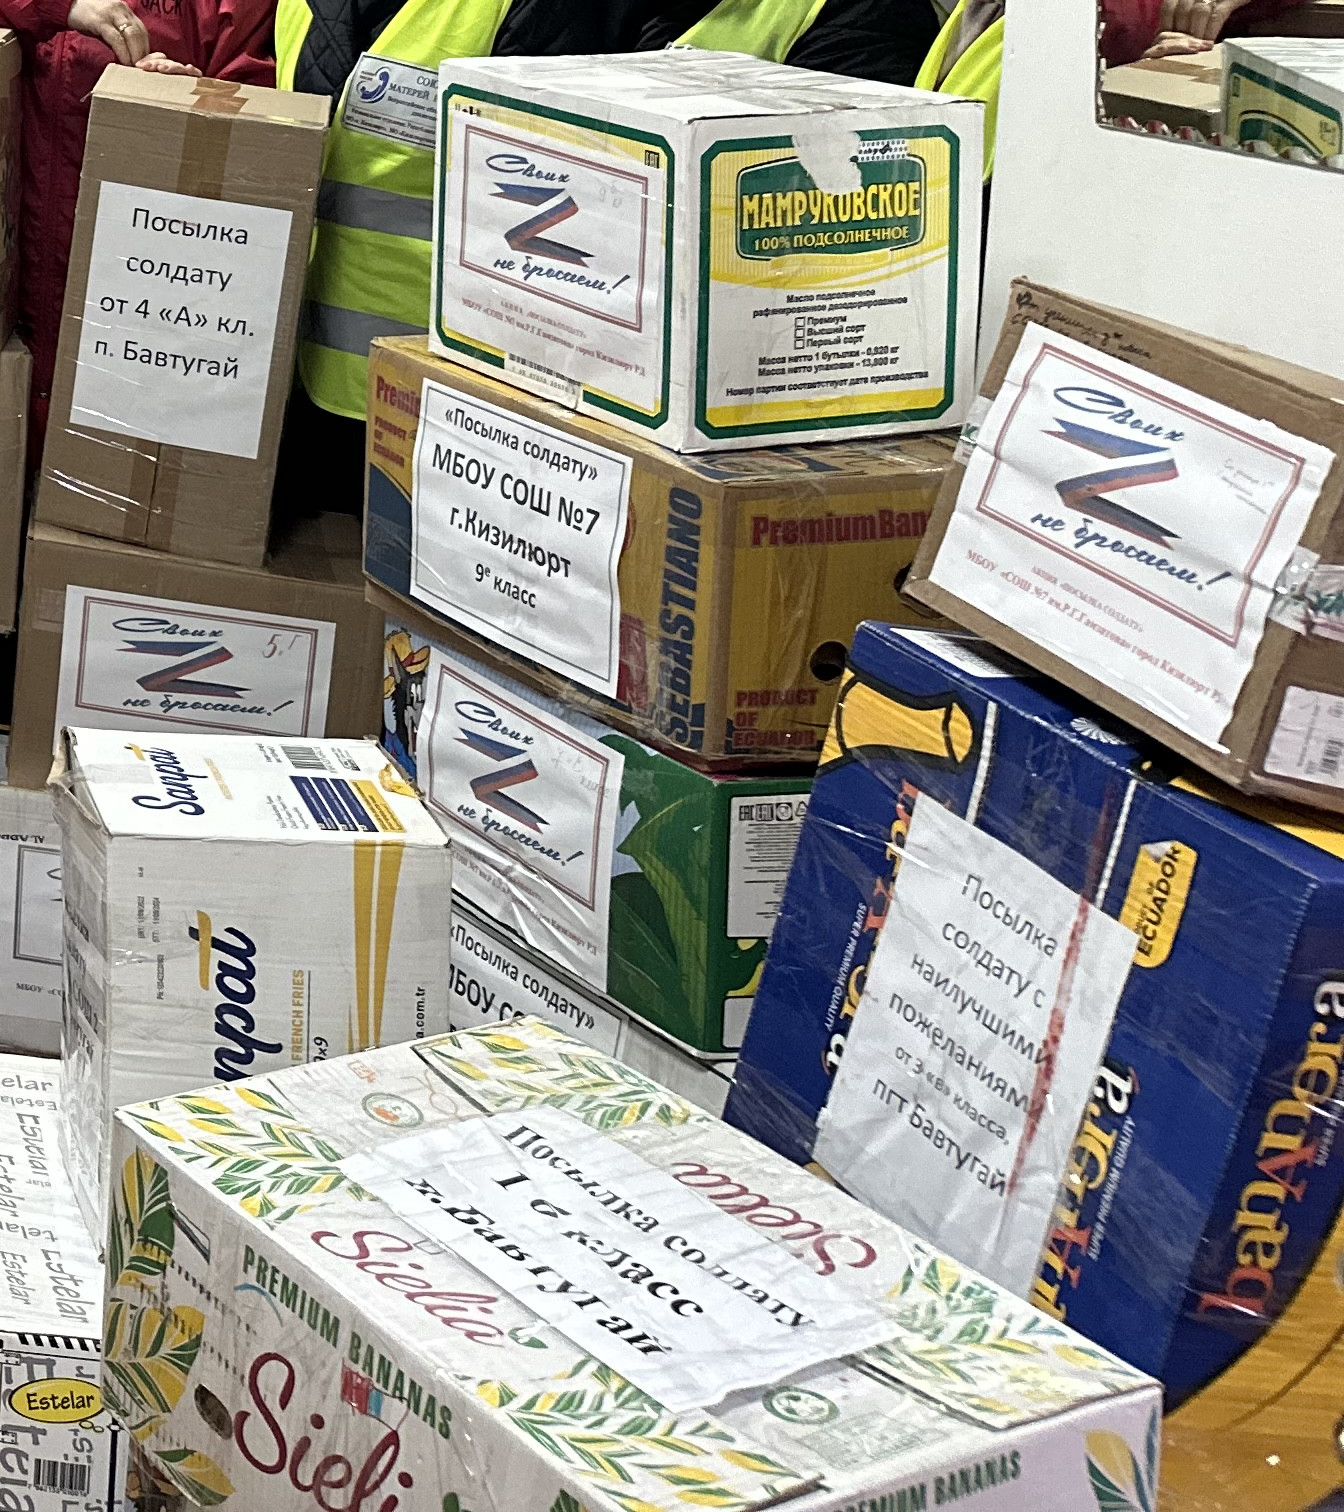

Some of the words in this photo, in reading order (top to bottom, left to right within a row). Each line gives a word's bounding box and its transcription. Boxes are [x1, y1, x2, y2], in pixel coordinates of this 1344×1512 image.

[131, 207, 250, 246] Посылка
[741, 181, 920, 231] МАМРУКОВСКОЕ
[753, 235, 791, 252] 100%
[793, 224, 910, 250] ПОДСОЛНЕЧНОЕ
[449, 503, 572, 579] г.Кизилюрт
[656, 487, 704, 745] SEBASTIANO
[734, 690, 818, 709] PRODUCT
[734, 711, 758, 729] OF
[961, 870, 1059, 958] Посылка
[292, 969, 305, 1008] FRIES
[941, 919, 1030, 990] солдату
[1033, 989, 1045, 1010] с
[291, 1012, 303, 1063] FRENCH
[910, 952, 1056, 1067] наилучшими
[888, 989, 1043, 1120] пожеланиями
[894, 1044, 913, 1063] от
[913, 1058, 925, 1077] 3
[952, 1094, 1010, 1148] класса,
[872, 1077, 910, 1117] пгт
[908, 1108, 1008, 1197] Бавтугай
[504, 1123, 659, 1238] Посылка
[663, 1230, 818, 1329] солдату
[242, 1244, 341, 1350] PREMIUM
[347, 1329, 454, 1442] BANANAS
[26, 1391, 95, 1411] Estelar
[932, 1450, 1023, 1502] BANANAS
